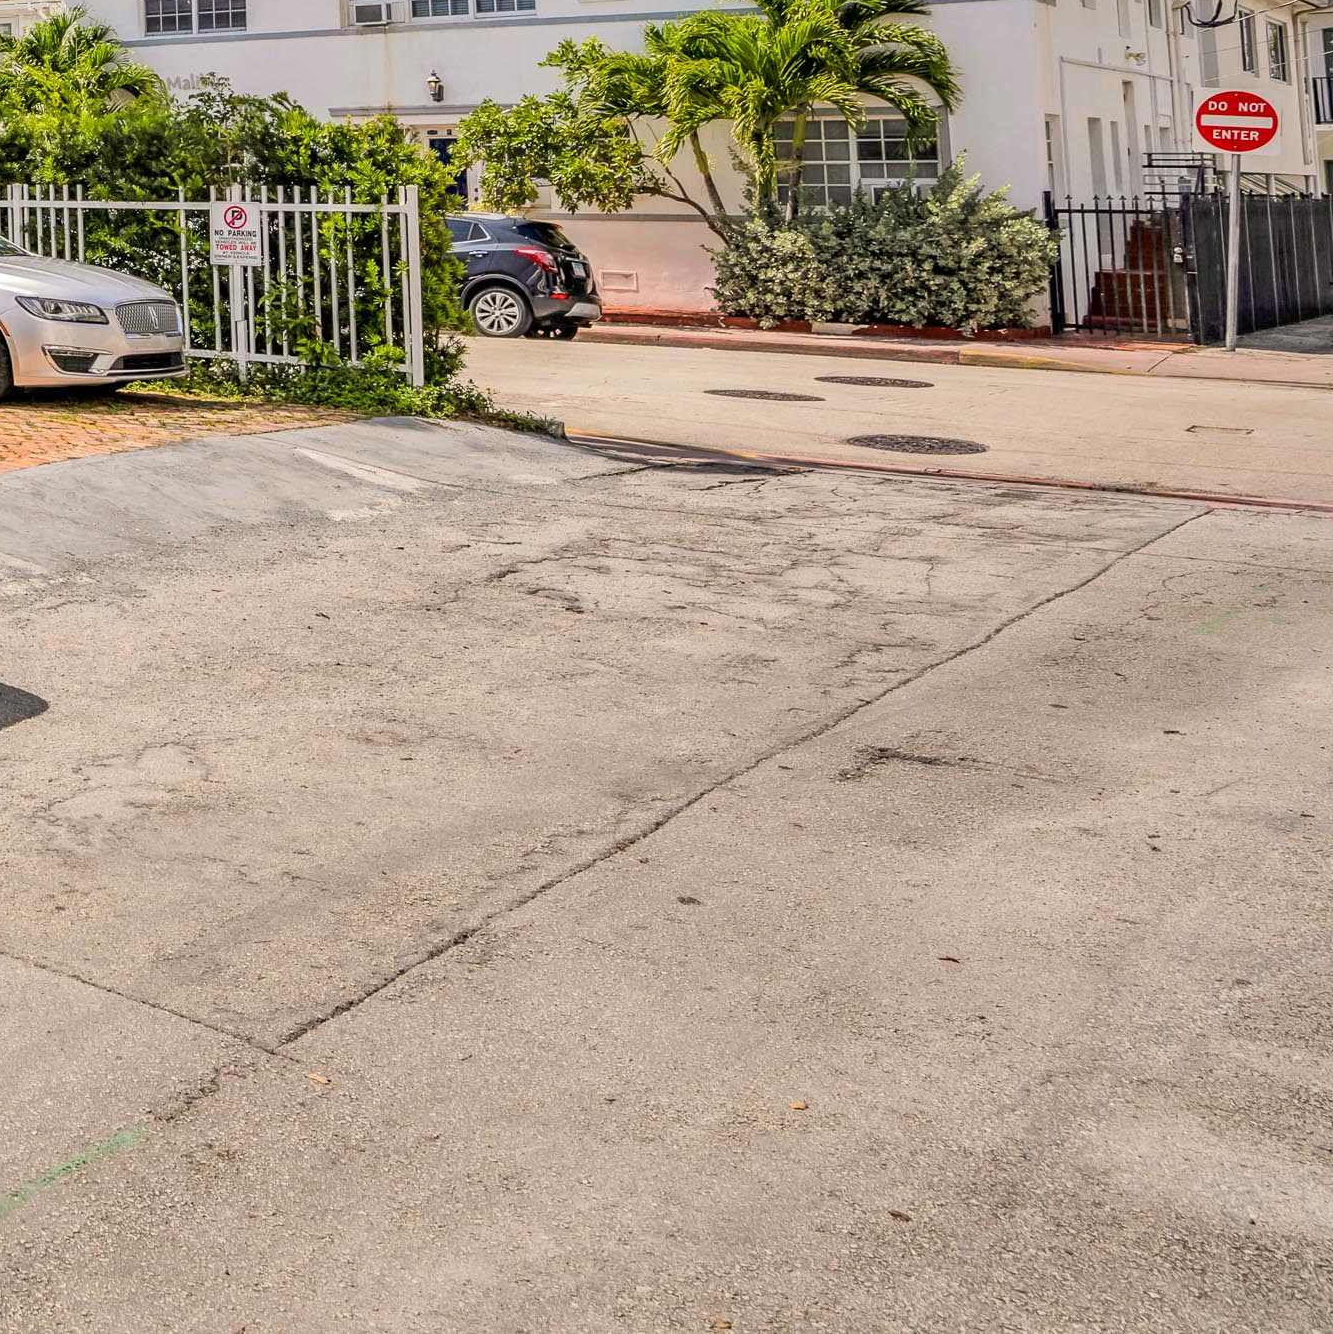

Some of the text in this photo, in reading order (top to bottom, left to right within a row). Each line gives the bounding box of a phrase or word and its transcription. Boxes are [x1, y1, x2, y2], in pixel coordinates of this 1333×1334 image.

[1208, 100, 1266, 113] DO NOT
[1212, 129, 1259, 141] ENTER
